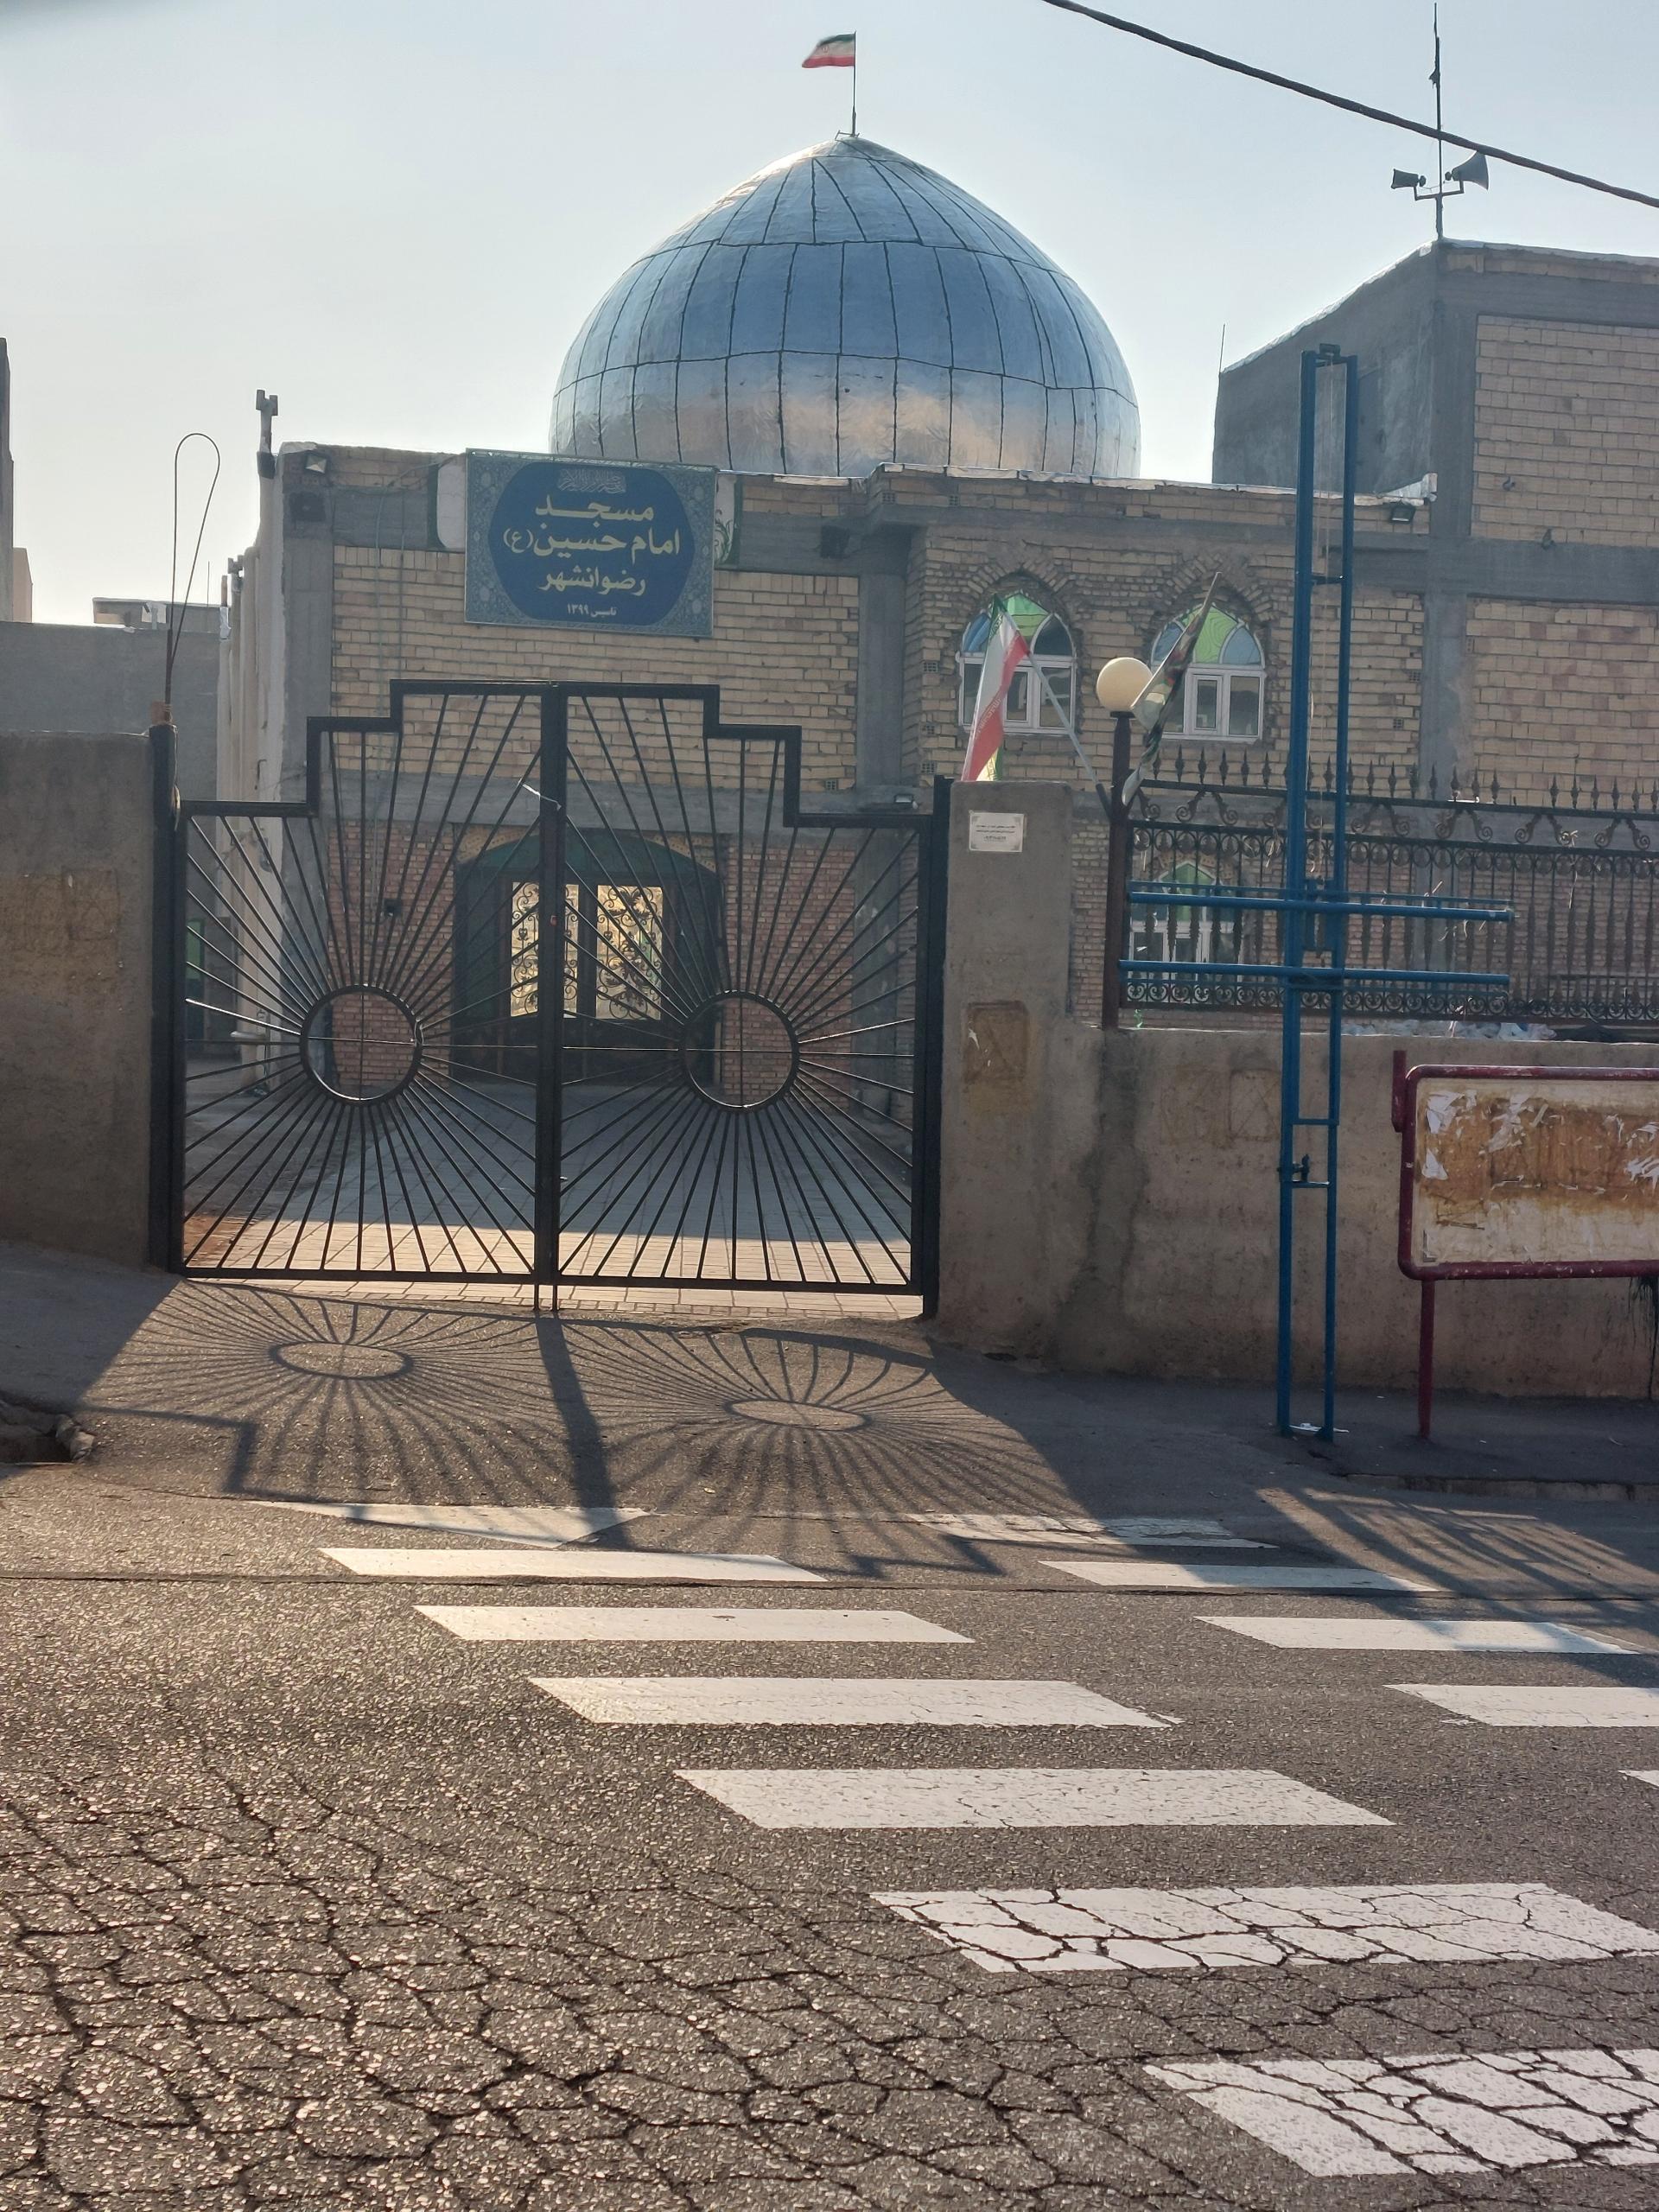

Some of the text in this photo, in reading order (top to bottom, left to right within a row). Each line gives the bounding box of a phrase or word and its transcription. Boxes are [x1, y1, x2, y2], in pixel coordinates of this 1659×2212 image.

[535, 494, 654, 529] مسجد
[630, 527, 681, 566] امام
[537, 564, 646, 596] رضوانشهر
